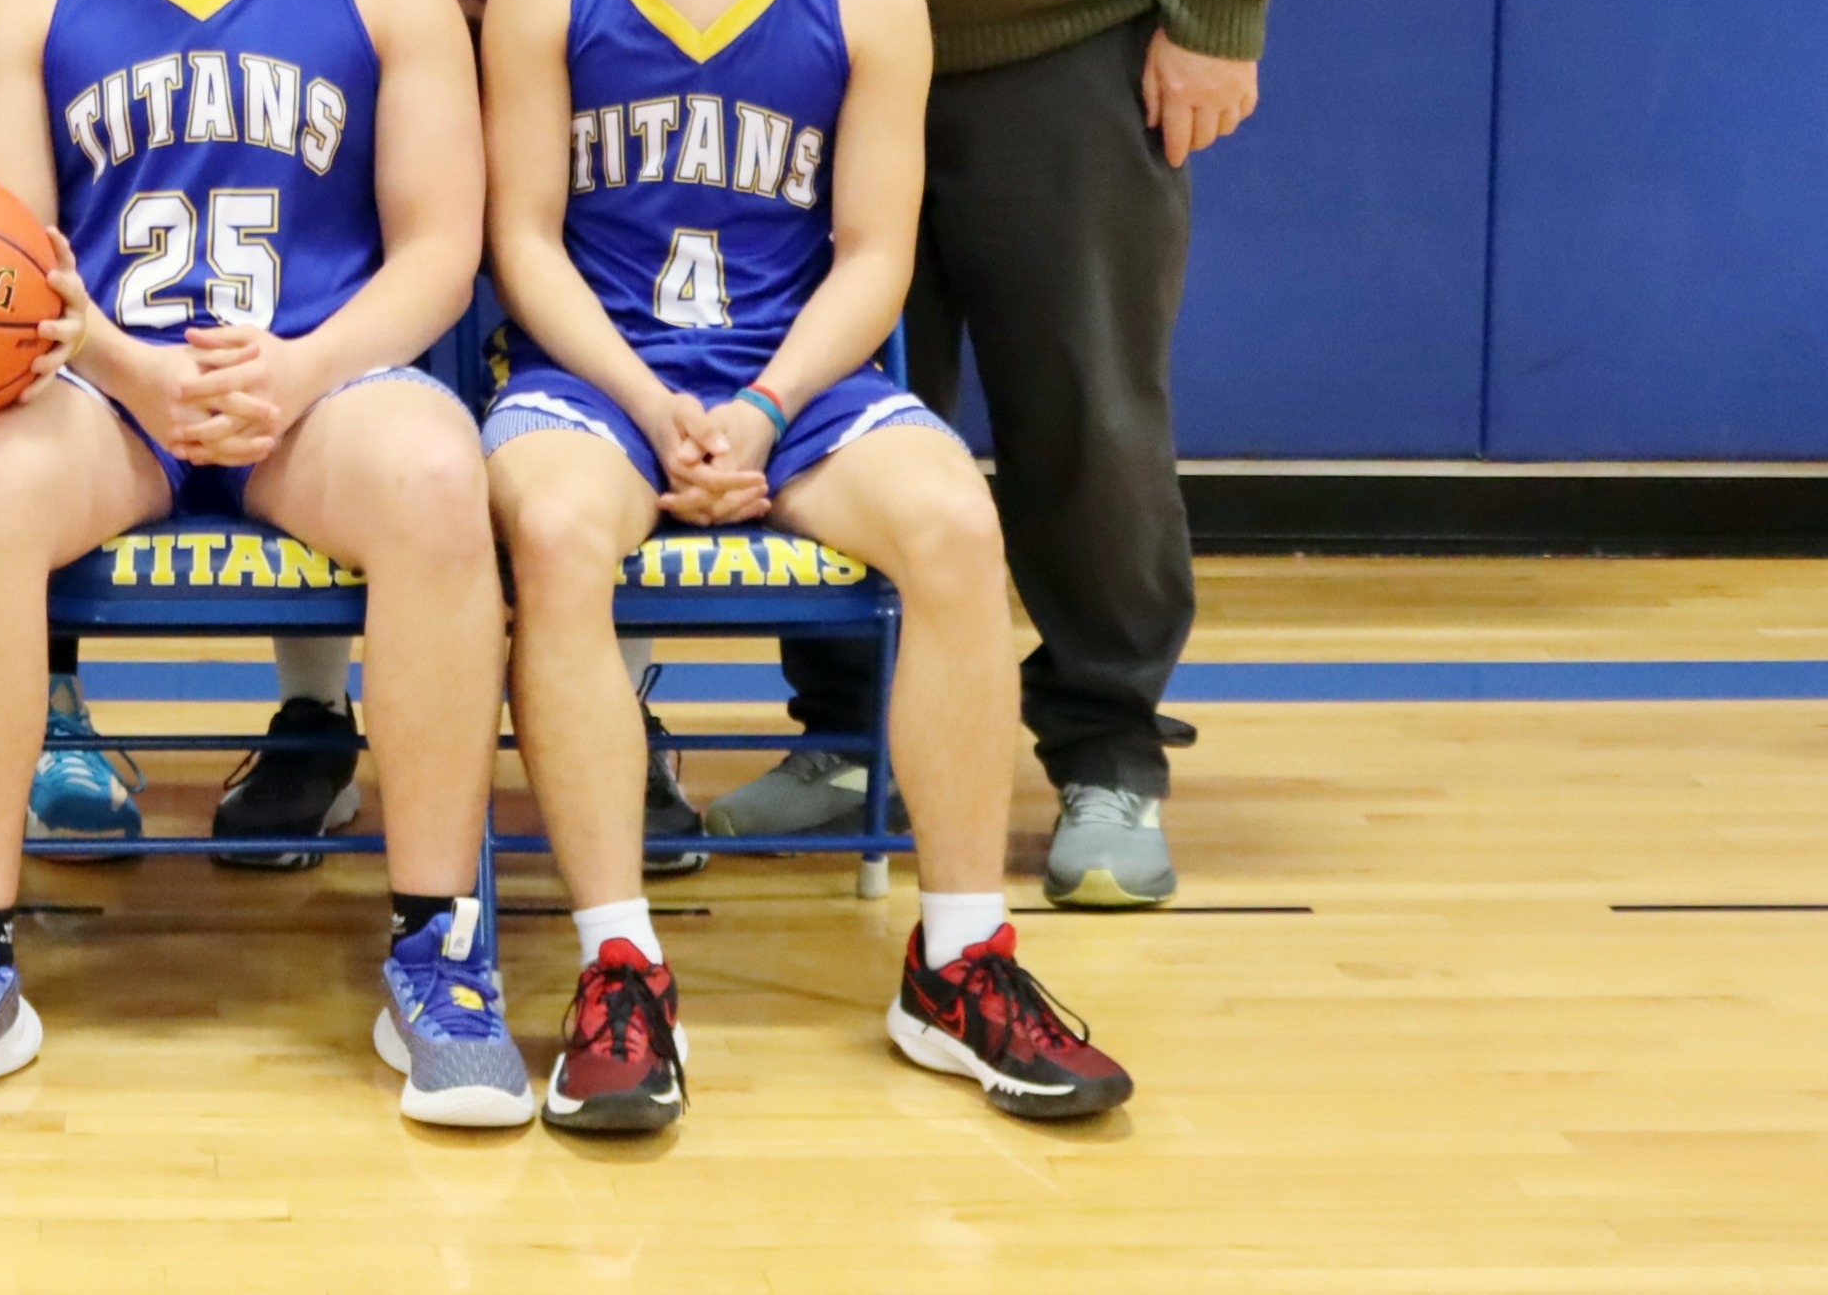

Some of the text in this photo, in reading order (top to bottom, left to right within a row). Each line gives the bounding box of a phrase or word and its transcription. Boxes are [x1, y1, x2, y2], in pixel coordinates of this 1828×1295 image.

[64, 50, 347, 186] TITANS
[571, 93, 823, 210] TITANS
[115, 187, 281, 332] 25
[653, 227, 733, 329] 4
[615, 536, 868, 587] ITANS
